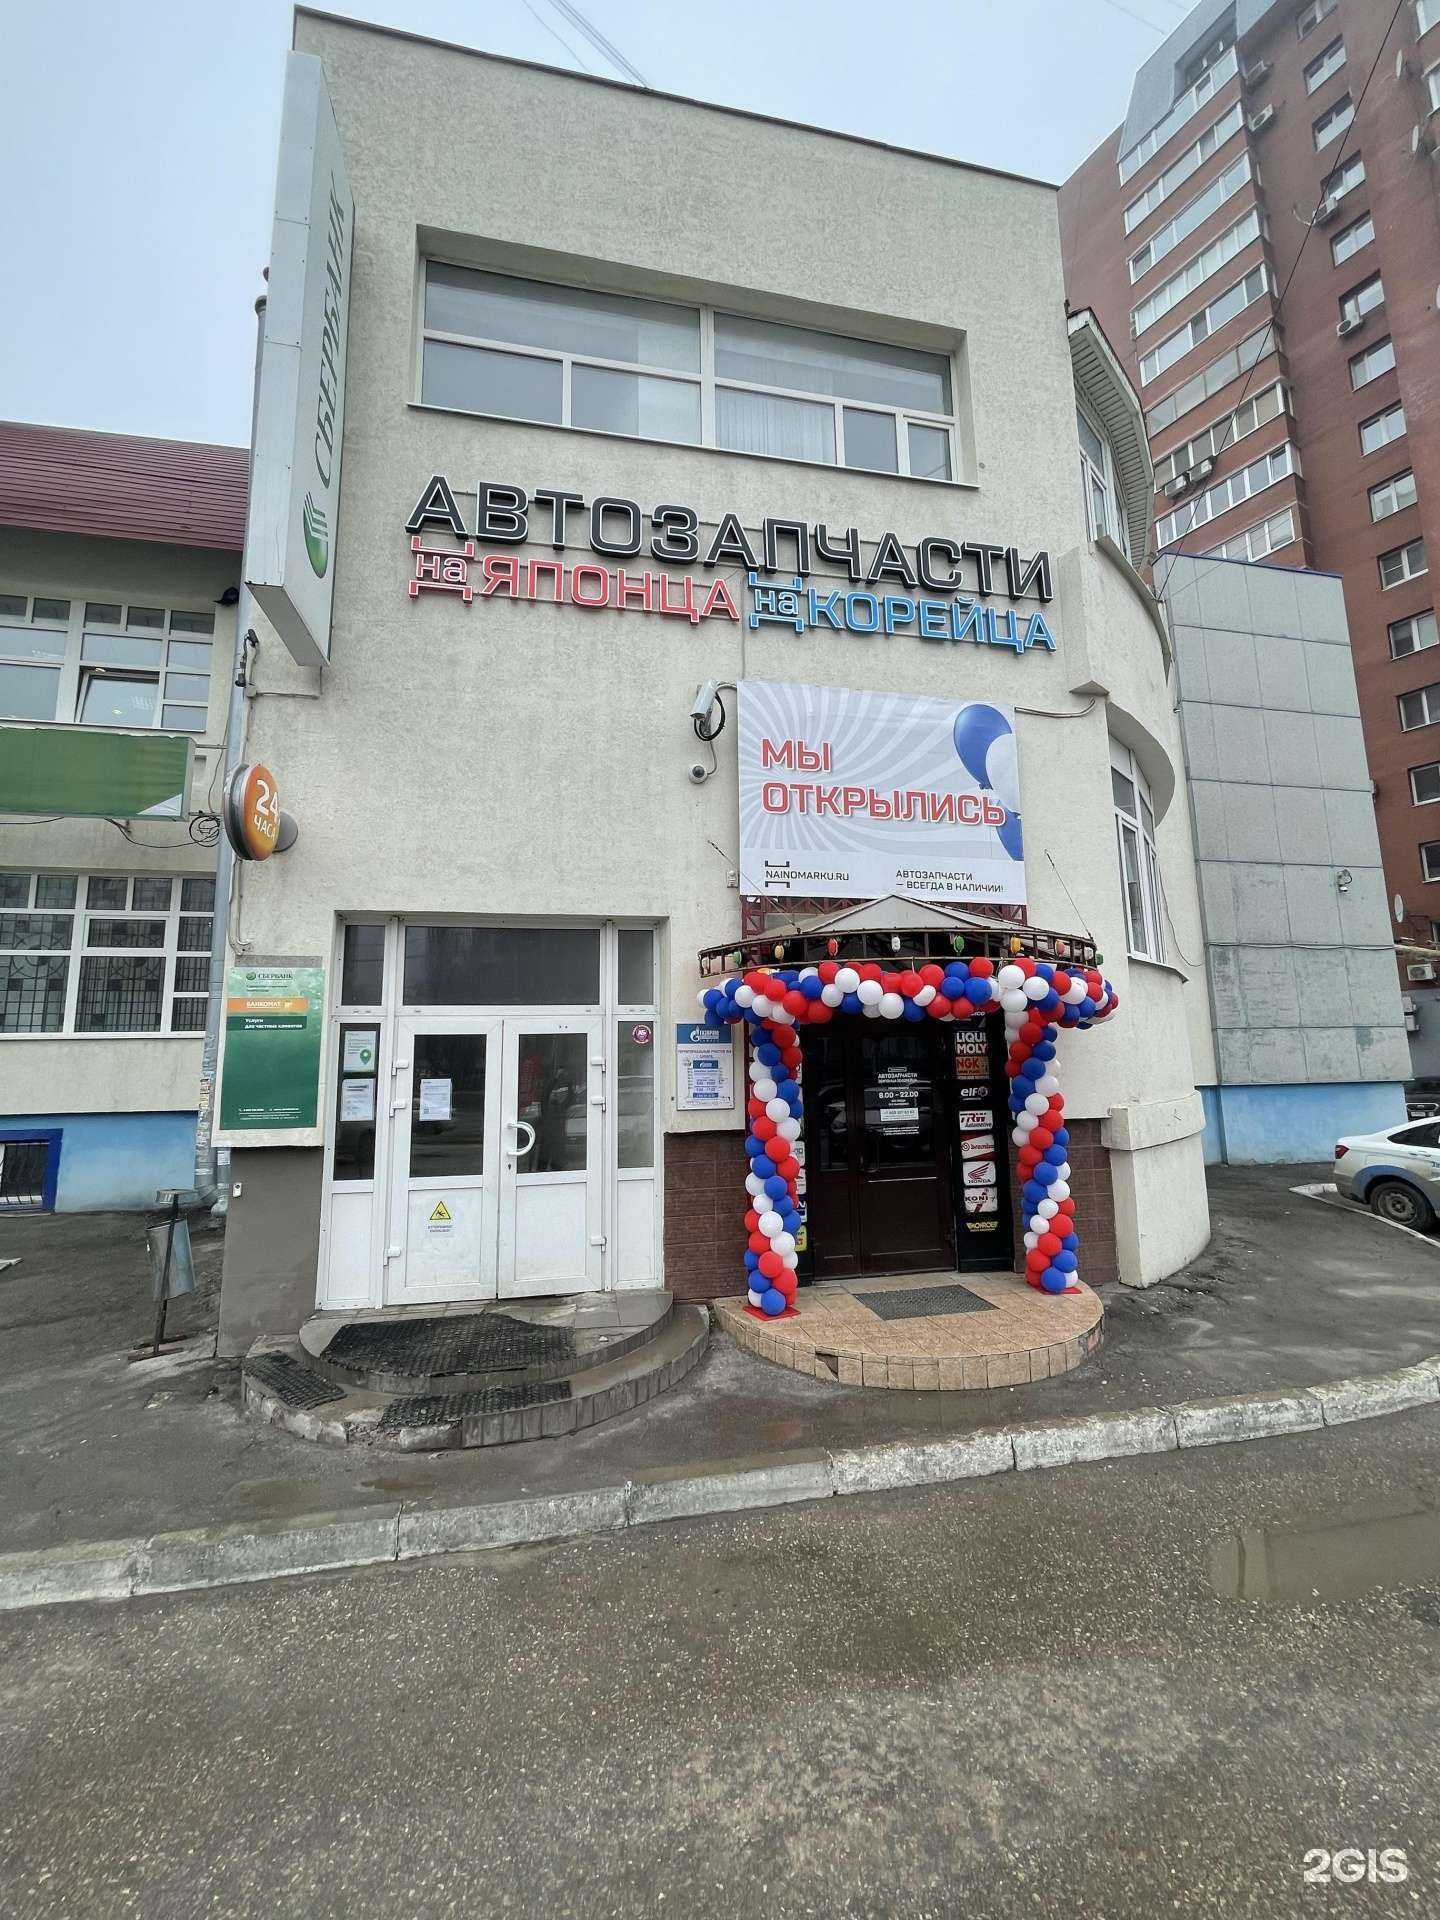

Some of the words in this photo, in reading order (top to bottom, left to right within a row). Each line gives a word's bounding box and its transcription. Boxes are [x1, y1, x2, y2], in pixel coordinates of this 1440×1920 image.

[315, 170, 345, 489] СБЕРБАНК
[405, 474, 1054, 602] АВТОЗАПЧАСТИ
[482, 554, 741, 626] ЯПОНЦА
[809, 588, 1058, 655] КОРЕЙЦА
[761, 738, 831, 772] МЫ
[256, 779, 278, 824] 24
[762, 782, 1006, 825] ОТКРЫЛИСЬ
[765, 870, 849, 881] NAINOMARKU.RU
[896, 869, 973, 881] АВТОЗАПЧАСТИ
[906, 881, 944, 892] ВСЕГДА
[946, 882, 953, 891] В
[956, 1031, 986, 1043] LIQUI
[956, 1043, 987, 1055] MOLY
[956, 1057, 979, 1069] NGK
[960, 1087, 979, 1097] elf
